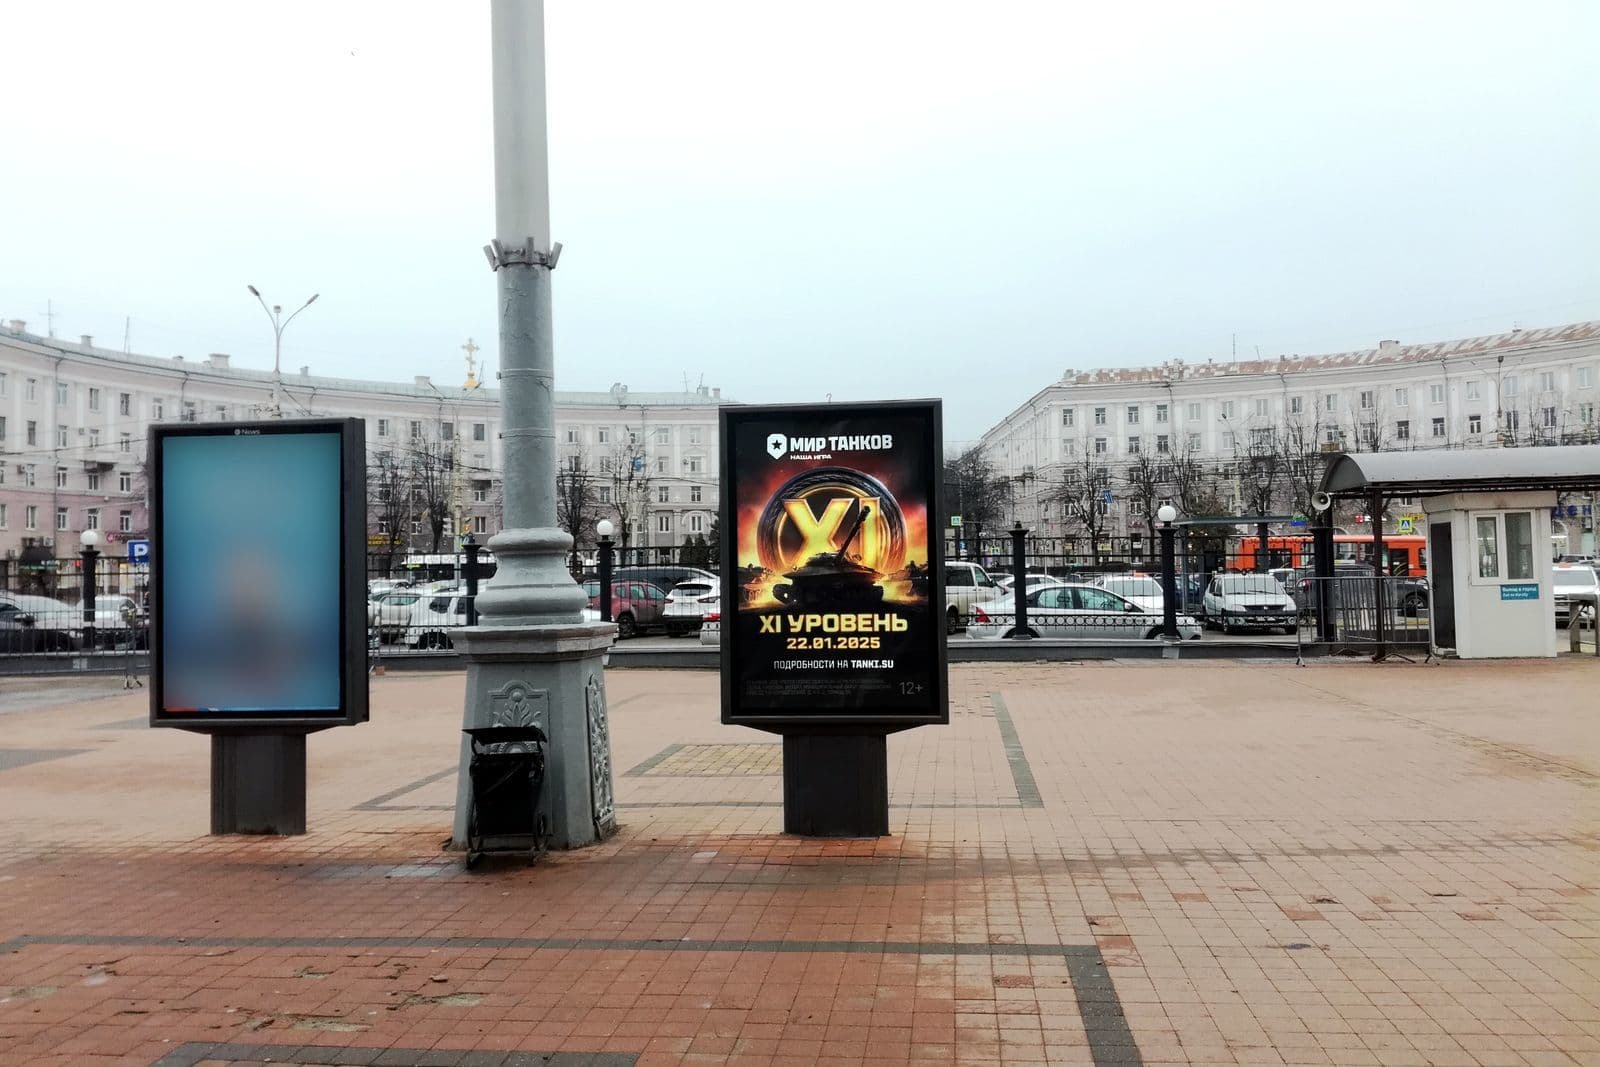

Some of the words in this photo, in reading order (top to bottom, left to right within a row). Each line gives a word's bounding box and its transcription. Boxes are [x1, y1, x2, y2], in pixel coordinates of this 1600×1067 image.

[790, 437, 826, 452] МИР
[828, 434, 893, 451] ТАНКОВ
[134, 543, 149, 557] P
[787, 613, 909, 633] УРОВЕНЬ
[786, 636, 881, 650] 22.01.2025
[773, 660, 835, 670] ПОДРОБНОСТИ
[837, 660, 849, 669] НА
[850, 659, 894, 669] TANKI.SU
[899, 681, 923, 695] 12+
